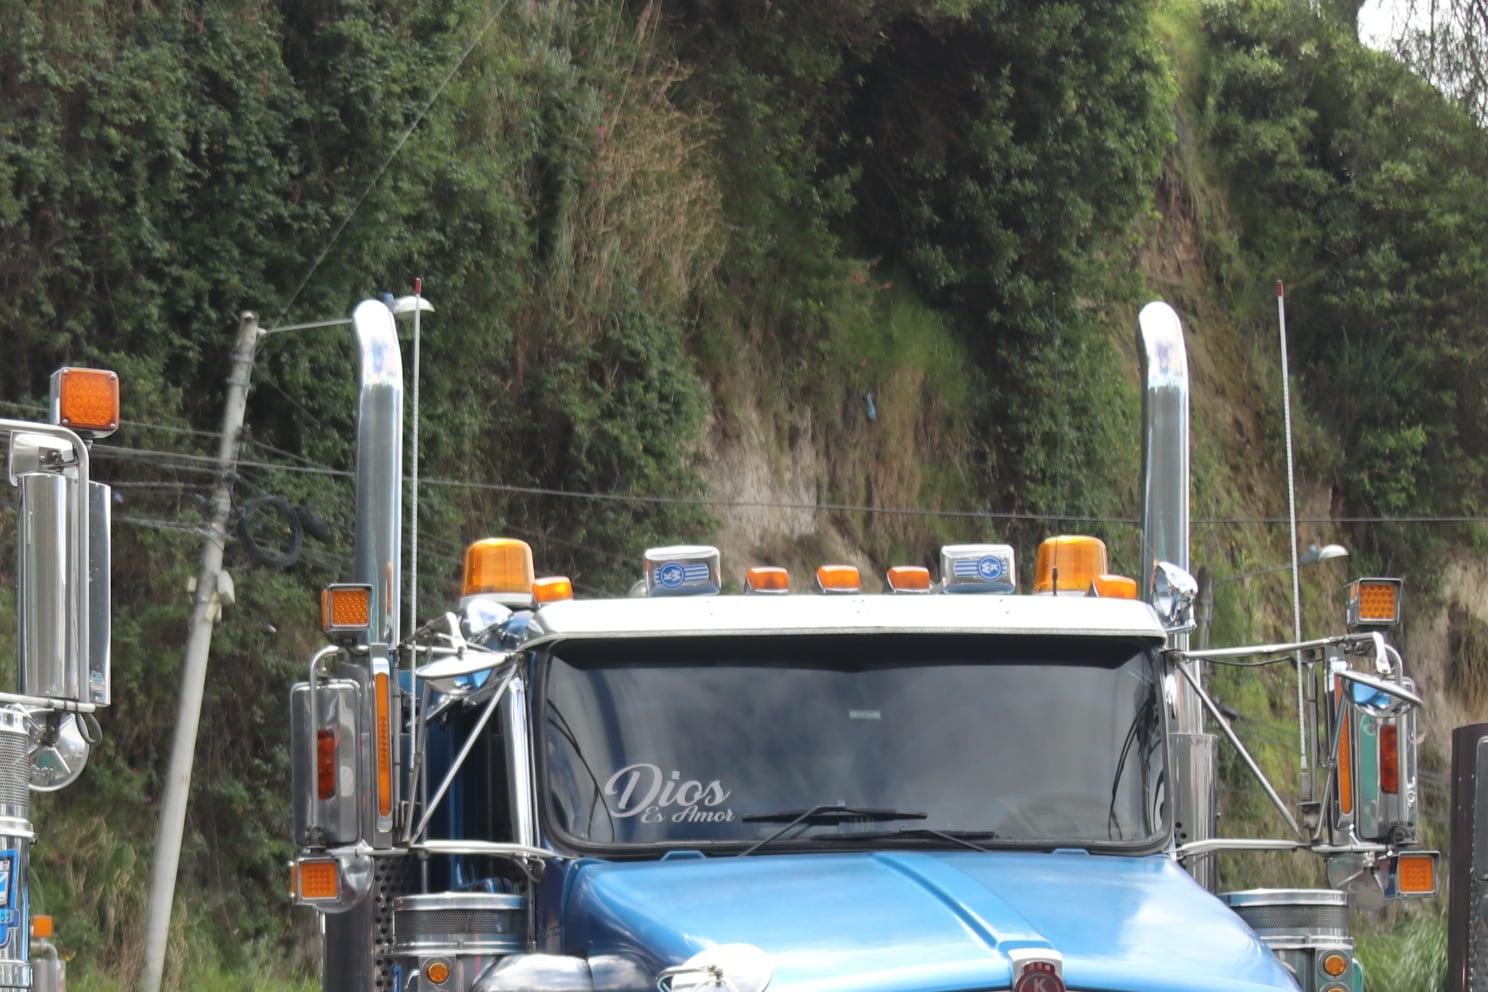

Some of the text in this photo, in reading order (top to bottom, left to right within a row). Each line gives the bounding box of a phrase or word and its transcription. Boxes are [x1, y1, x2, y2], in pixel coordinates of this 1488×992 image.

[604, 763, 731, 818] Dios
[640, 805, 735, 824] Es Amor
